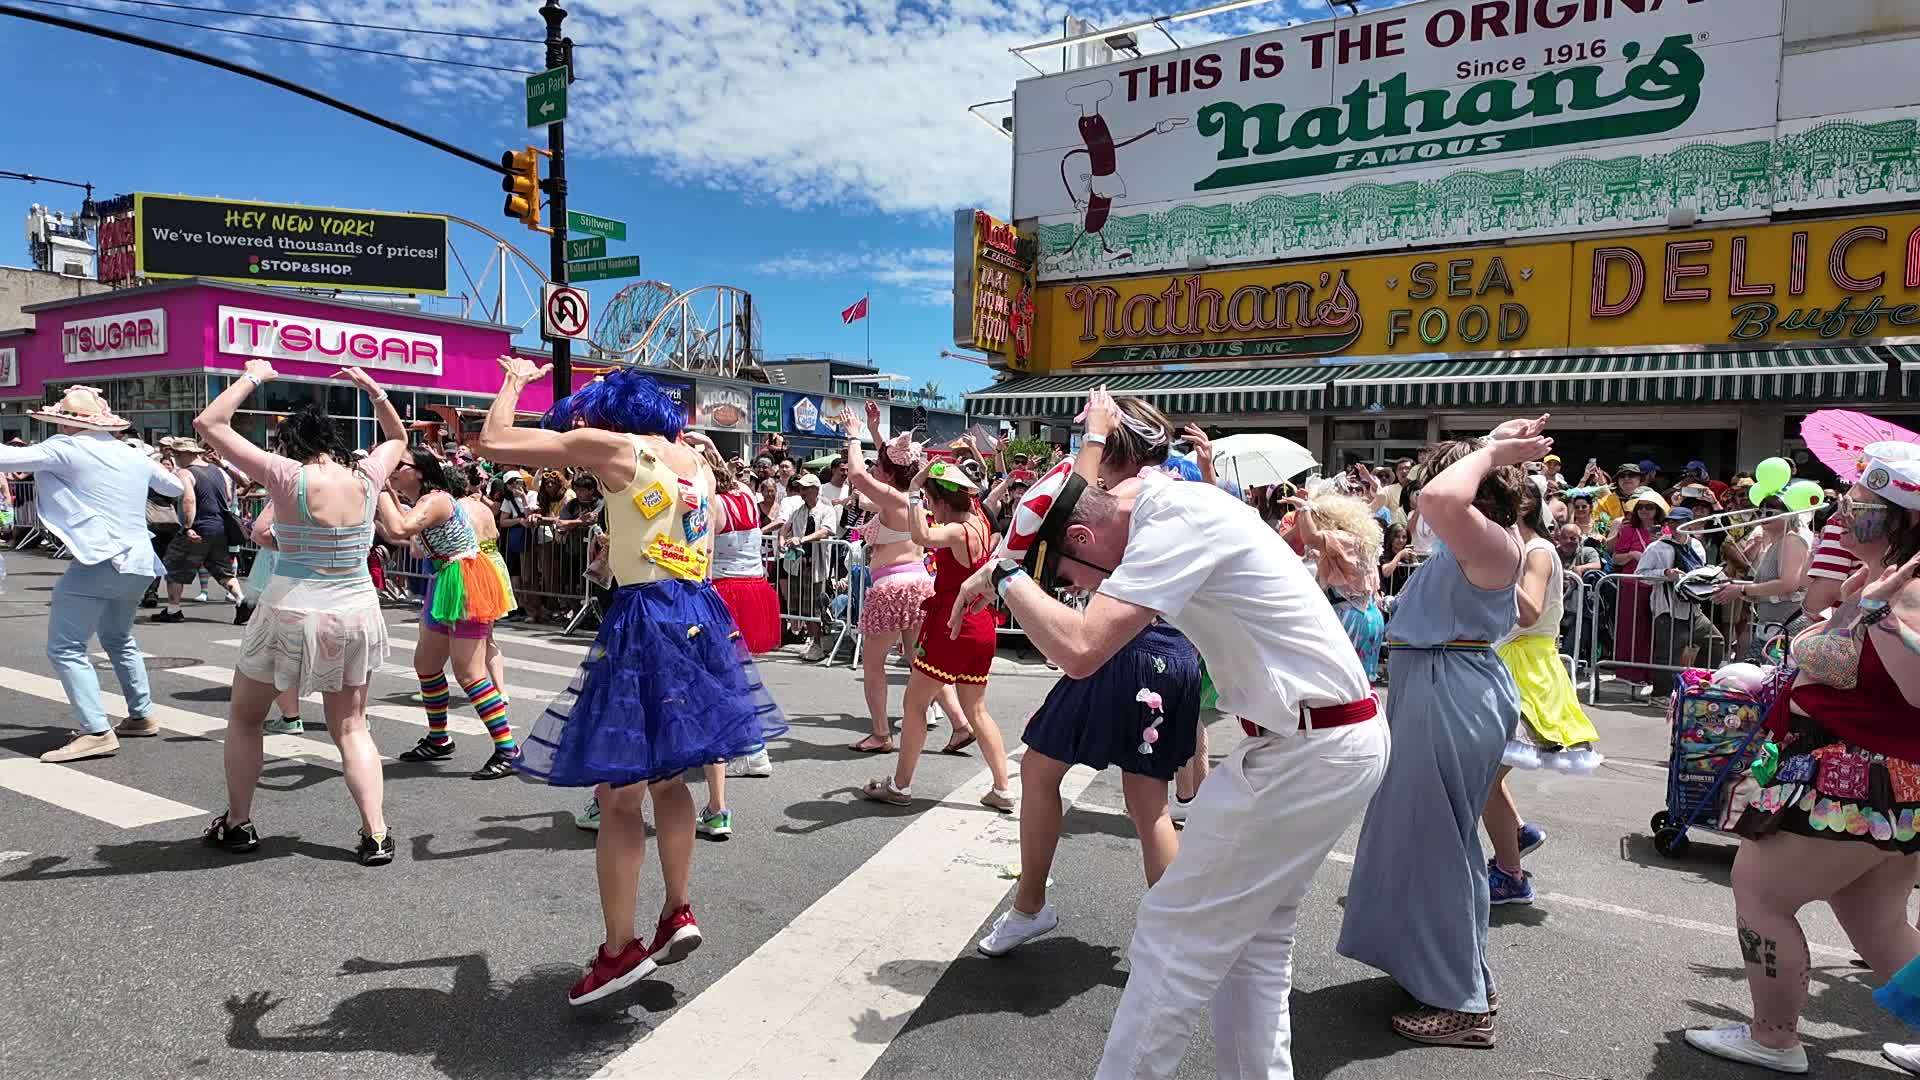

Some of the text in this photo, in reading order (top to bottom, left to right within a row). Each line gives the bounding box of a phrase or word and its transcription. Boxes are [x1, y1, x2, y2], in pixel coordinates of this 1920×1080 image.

[1118, 0, 1705, 102] THIS IS THE ORIGI
[1456, 38, 1607, 80] Since 1916
[528, 73, 566, 98] Luna Park
[1334, 134, 1509, 170] FAMOUS
[225, 209, 375, 238] HEY NEW YORK!
[580, 215, 614, 232] Stillwell
[152, 227, 438, 259] We've lowered thousands of prices!
[573, 241, 590, 257] Surf
[261, 259, 350, 275] STOP&SHOP
[981, 265, 1009, 292] TAKE
[1408, 256, 1514, 299] SEA
[1590, 224, 1920, 319] DELIC
[980, 290, 1009, 316] HOME
[977, 314, 1009, 343] FOOD
[1387, 303, 1529, 346] FOOD
[228, 316, 438, 367] IT'SUGAR
[1122, 341, 1245, 361] FAMOUS
[757, 407, 779, 417] Pkwy
[760, 398, 777, 407] Belt
